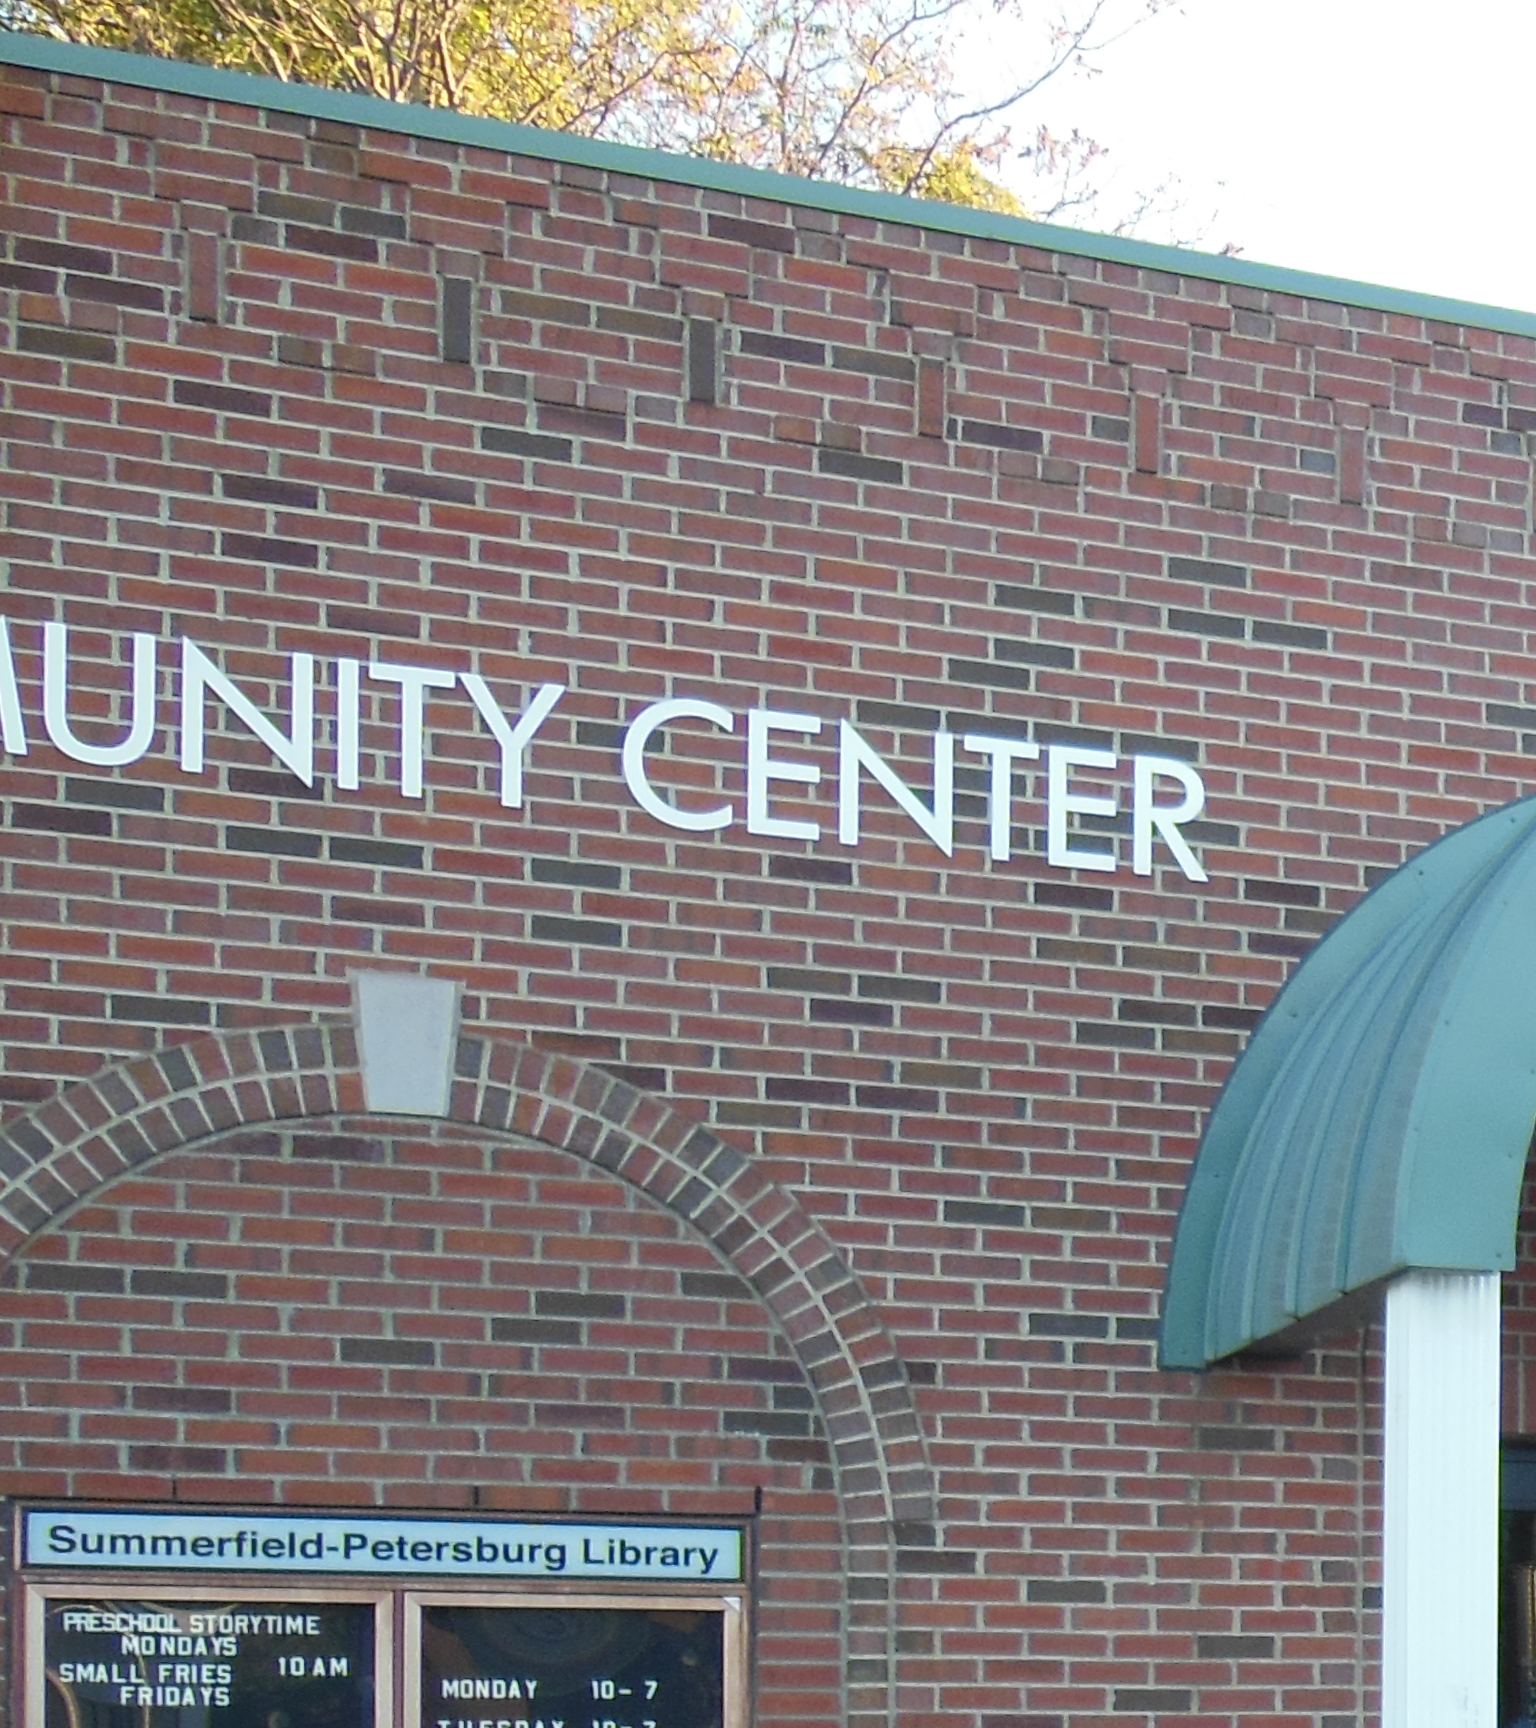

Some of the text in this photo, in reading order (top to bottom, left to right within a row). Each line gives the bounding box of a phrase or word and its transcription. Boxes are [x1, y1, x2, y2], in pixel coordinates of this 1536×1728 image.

[0, 614, 1209, 883] UNITY CENTER
[47, 1525, 719, 1574] Summerfield-Petersburg Library
[62, 1612, 321, 1635] PRESCHOOL STORYTIME
[121, 1636, 238, 1656] MONDAYS
[59, 1663, 232, 1684] SMALL FRIES
[120, 1686, 231, 1707] FRIDAYS
[442, 1679, 538, 1700] MONDAY
